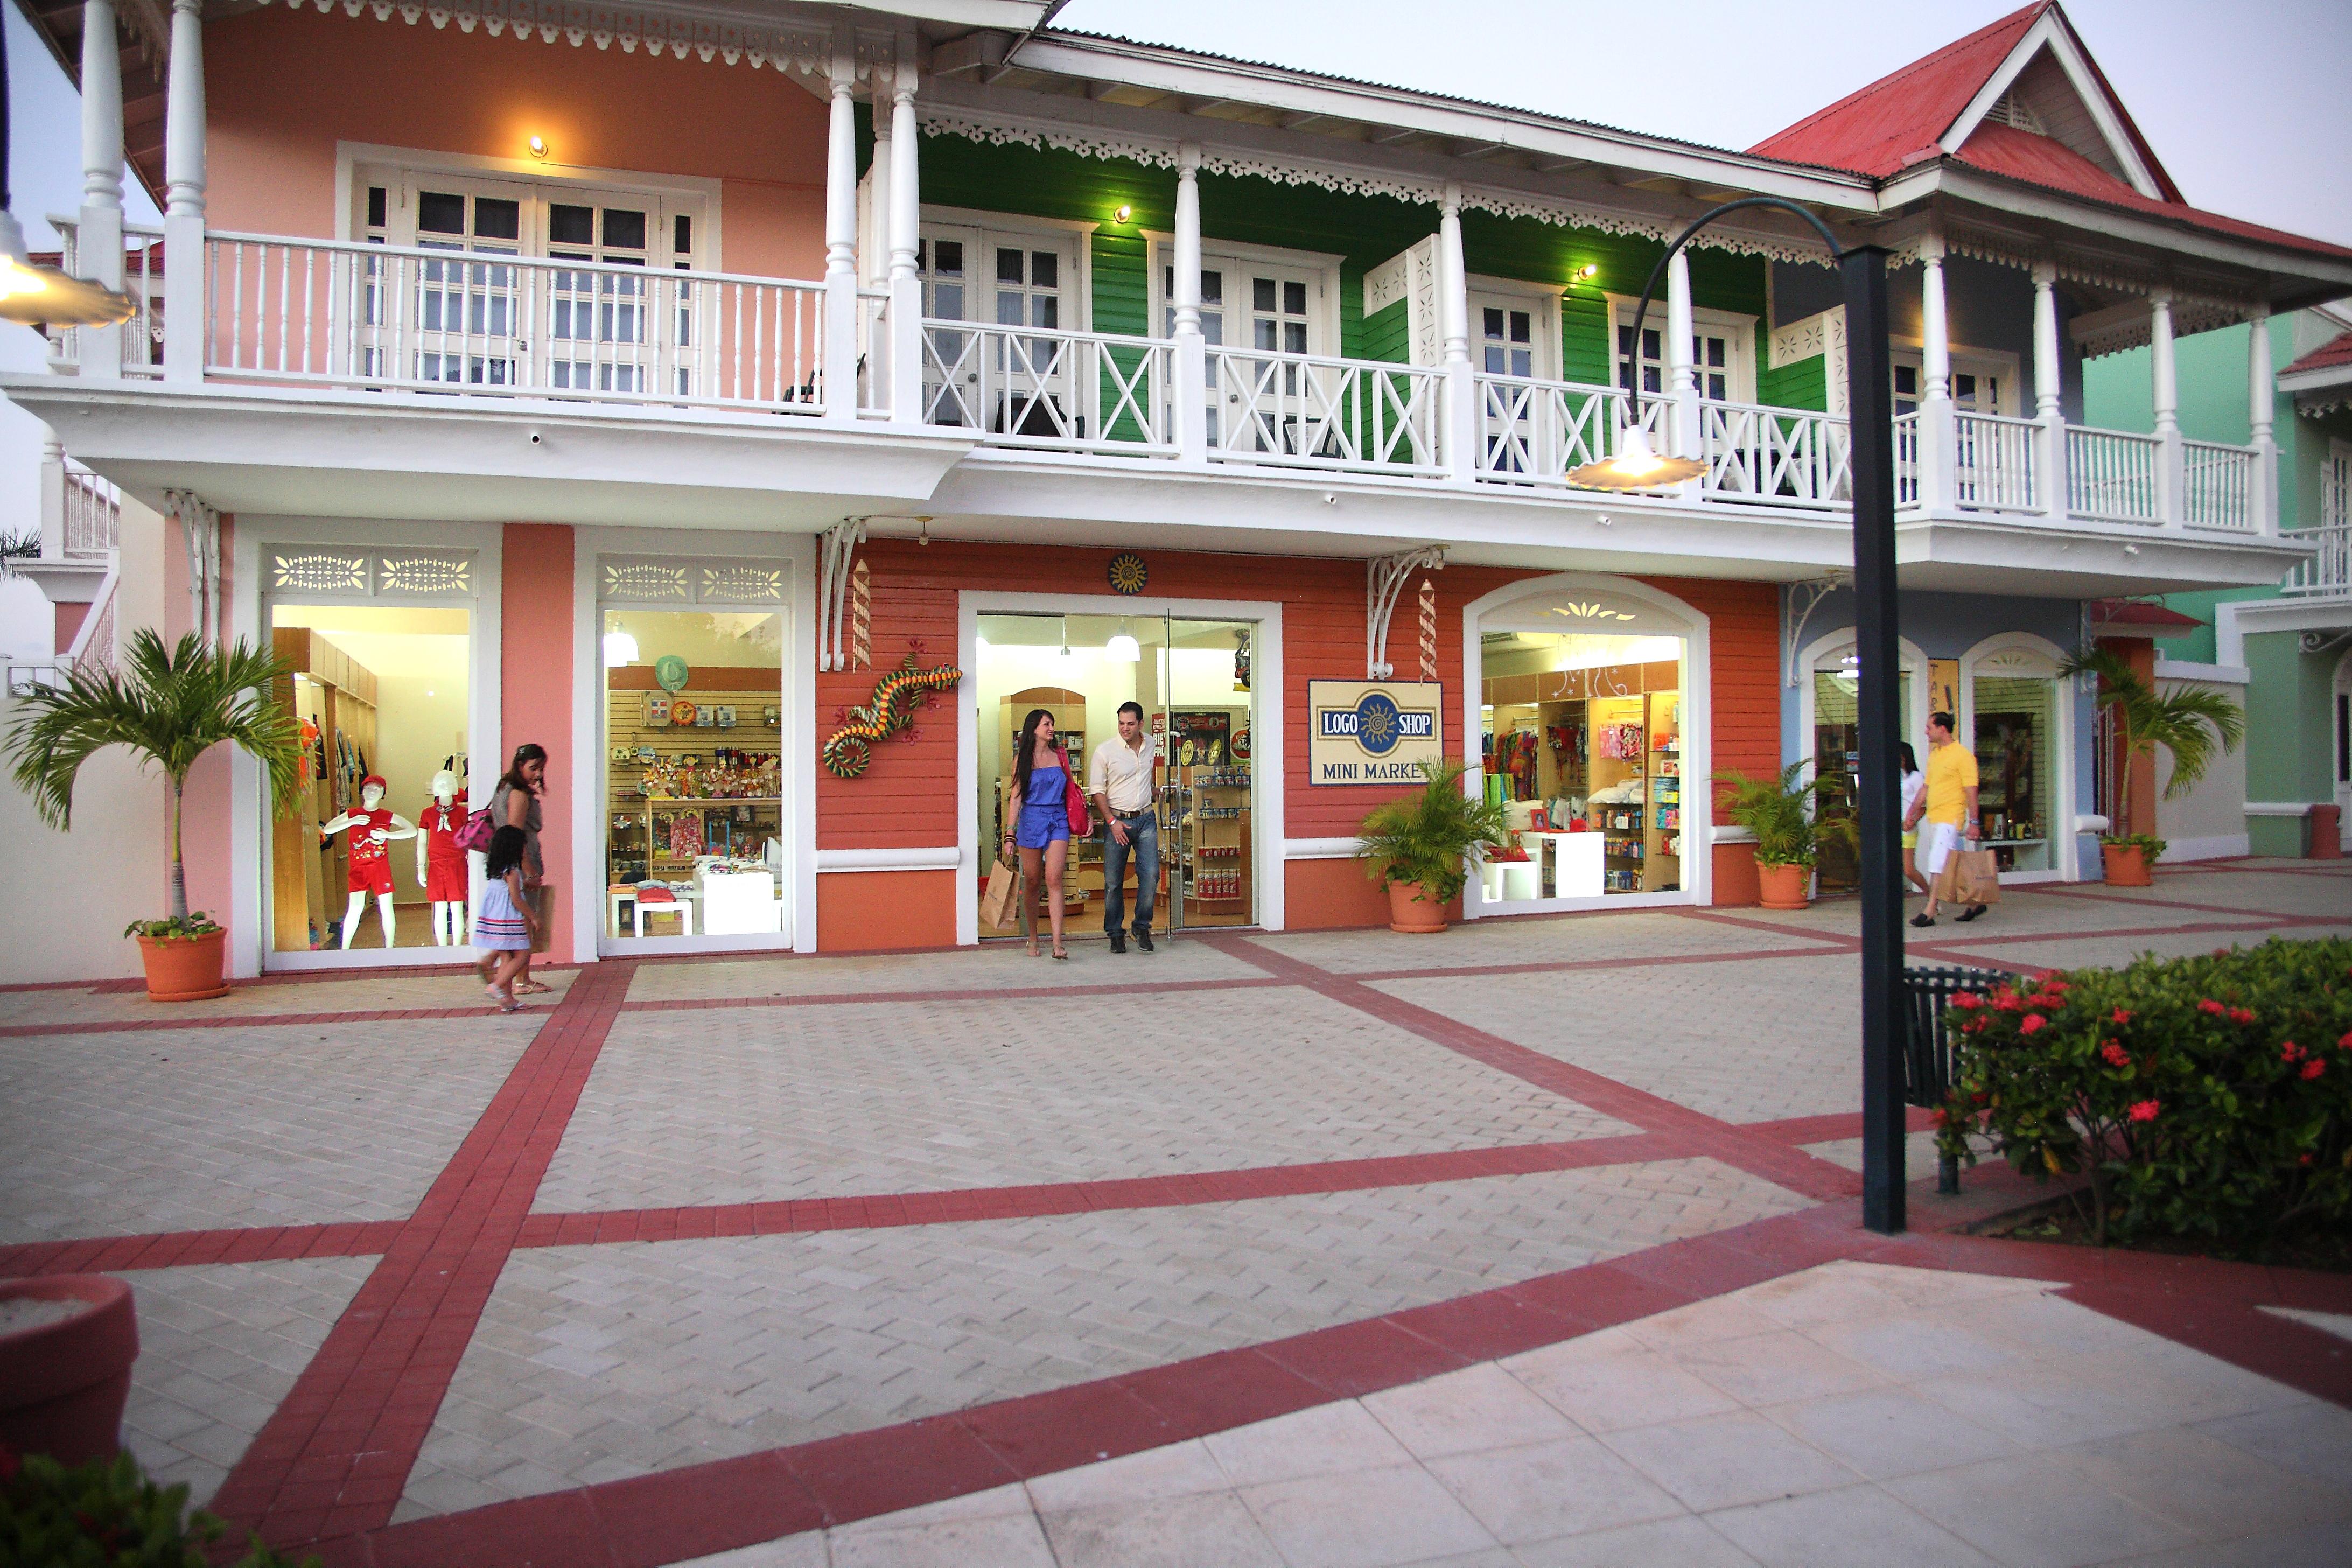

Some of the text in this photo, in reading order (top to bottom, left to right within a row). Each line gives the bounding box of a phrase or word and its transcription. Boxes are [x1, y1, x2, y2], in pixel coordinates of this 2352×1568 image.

[1324, 713, 1431, 734] LOGO SHOP
[1323, 762, 1431, 779] MINI MARKET
